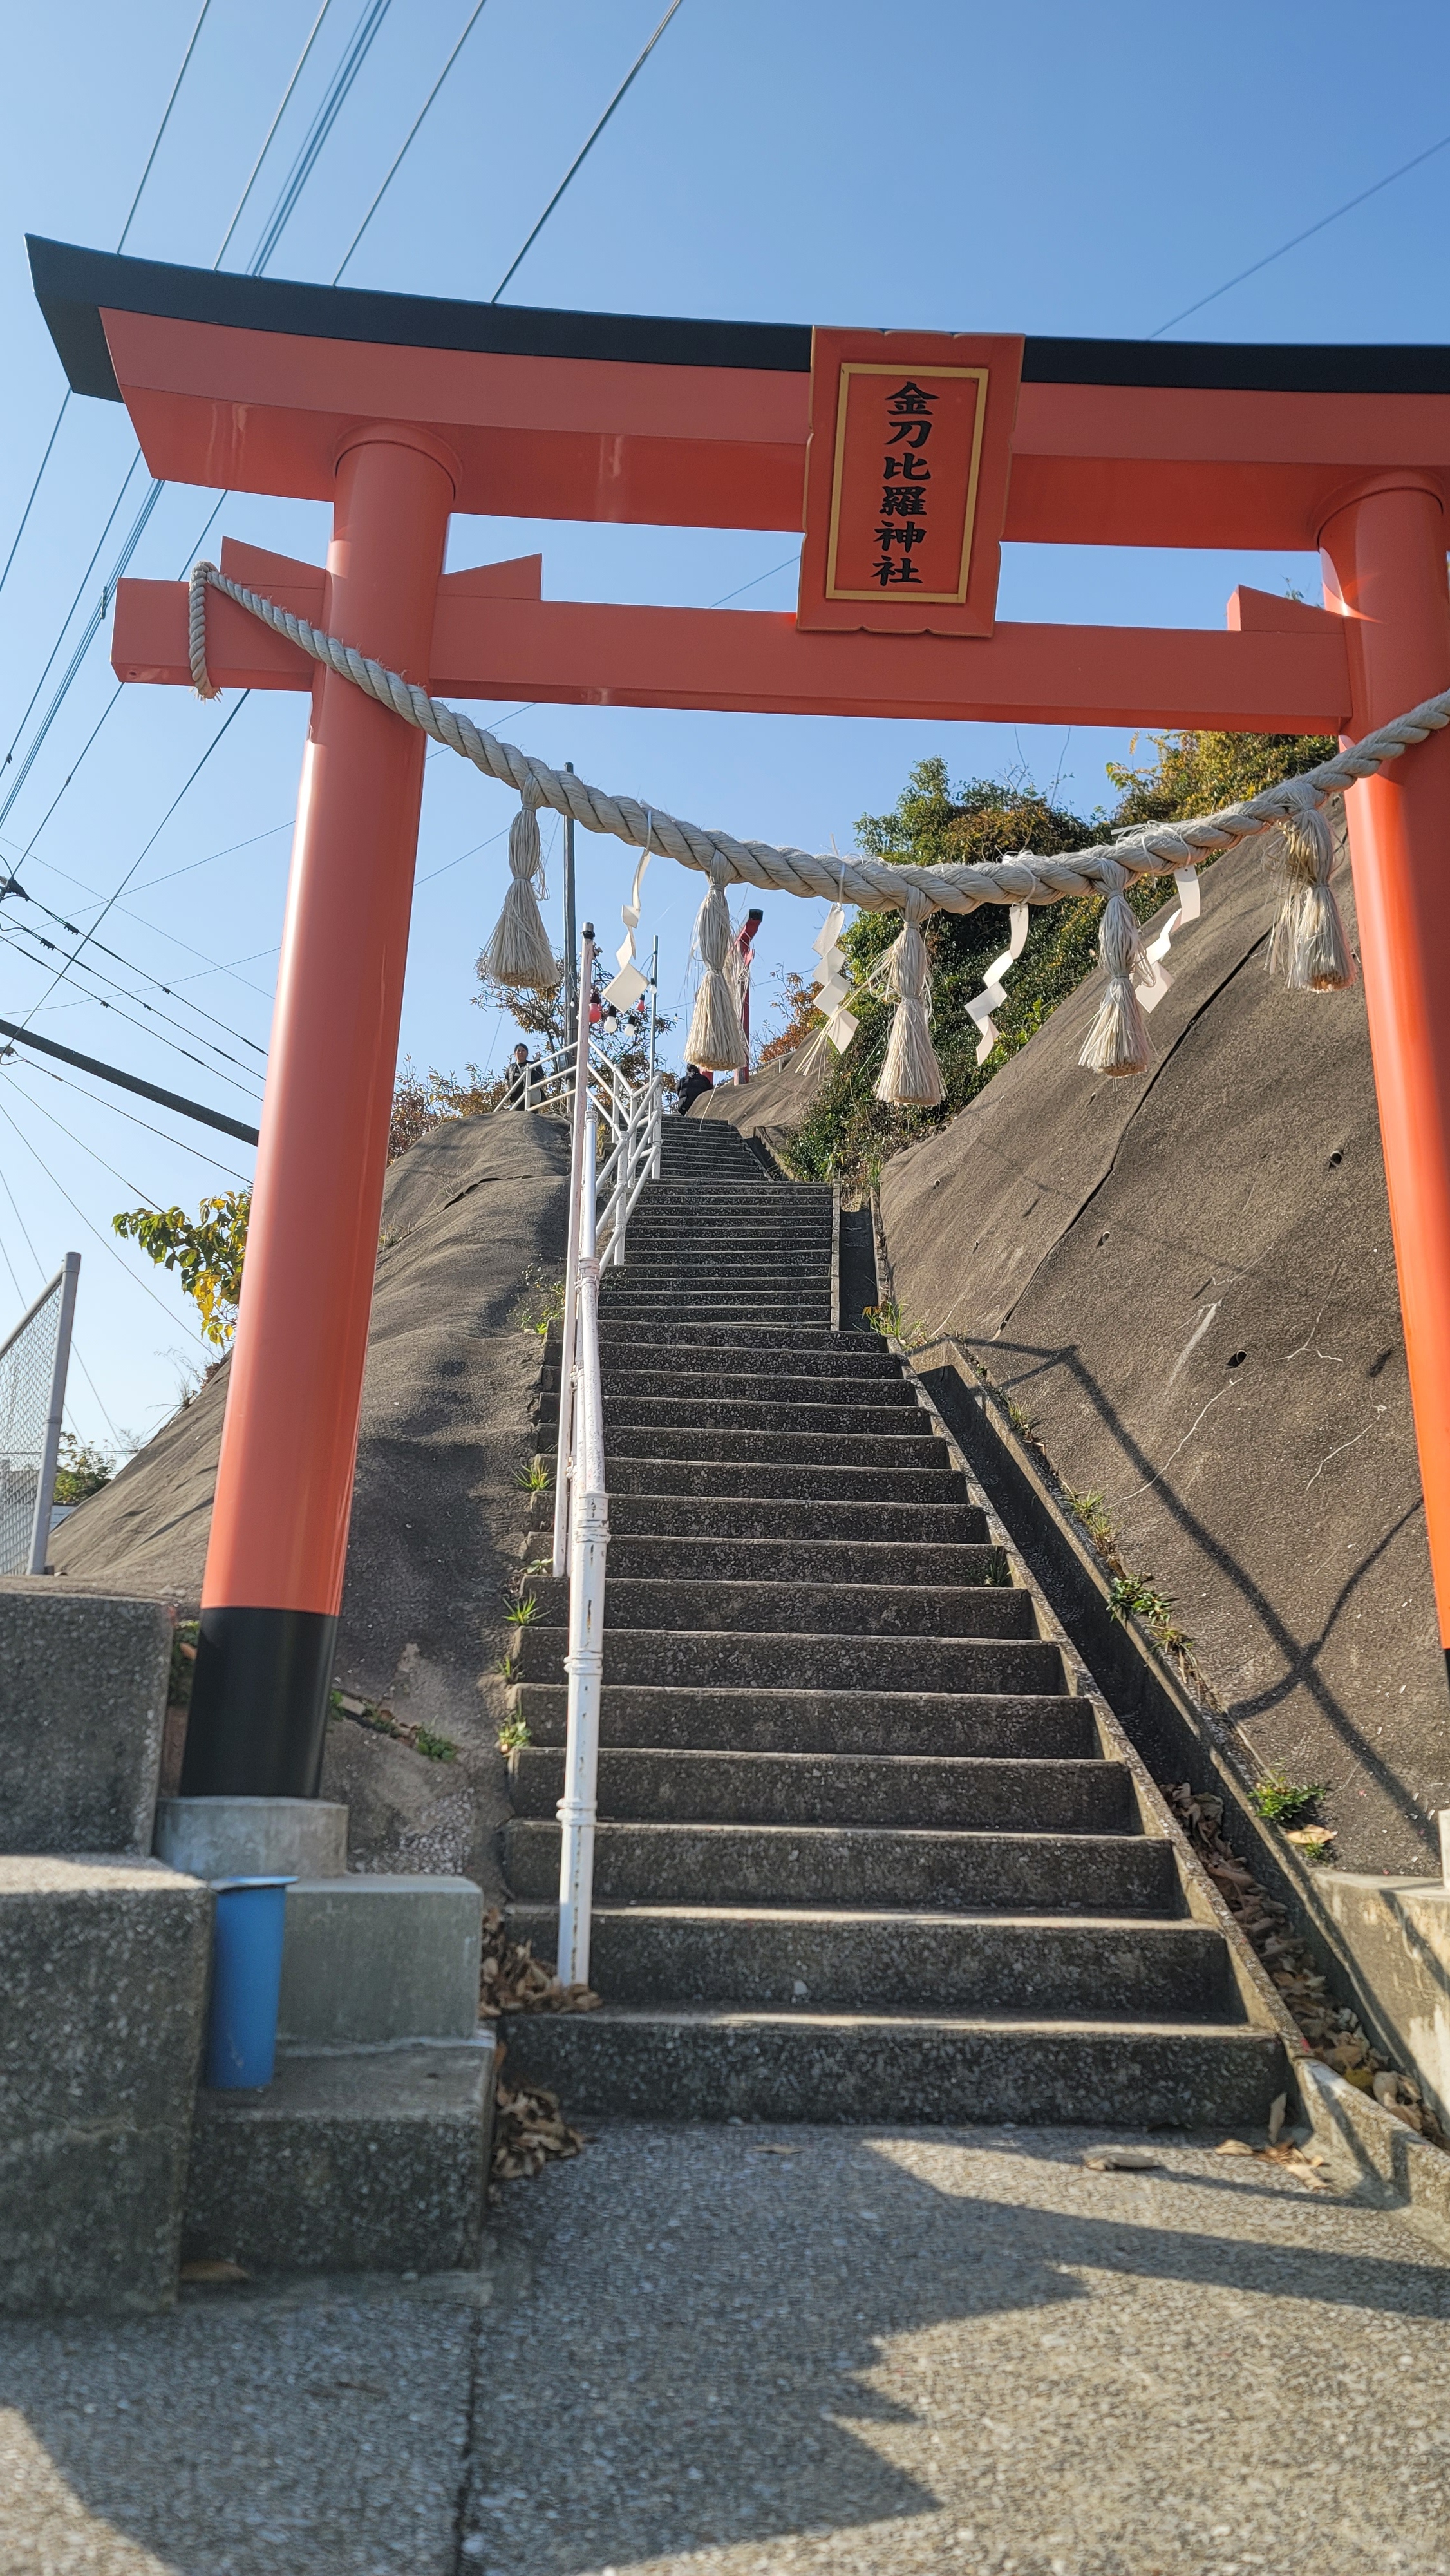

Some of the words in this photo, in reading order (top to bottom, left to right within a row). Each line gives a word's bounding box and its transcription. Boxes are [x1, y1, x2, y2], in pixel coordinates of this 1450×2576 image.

[870, 381, 939, 587] 金刀比羅神社
